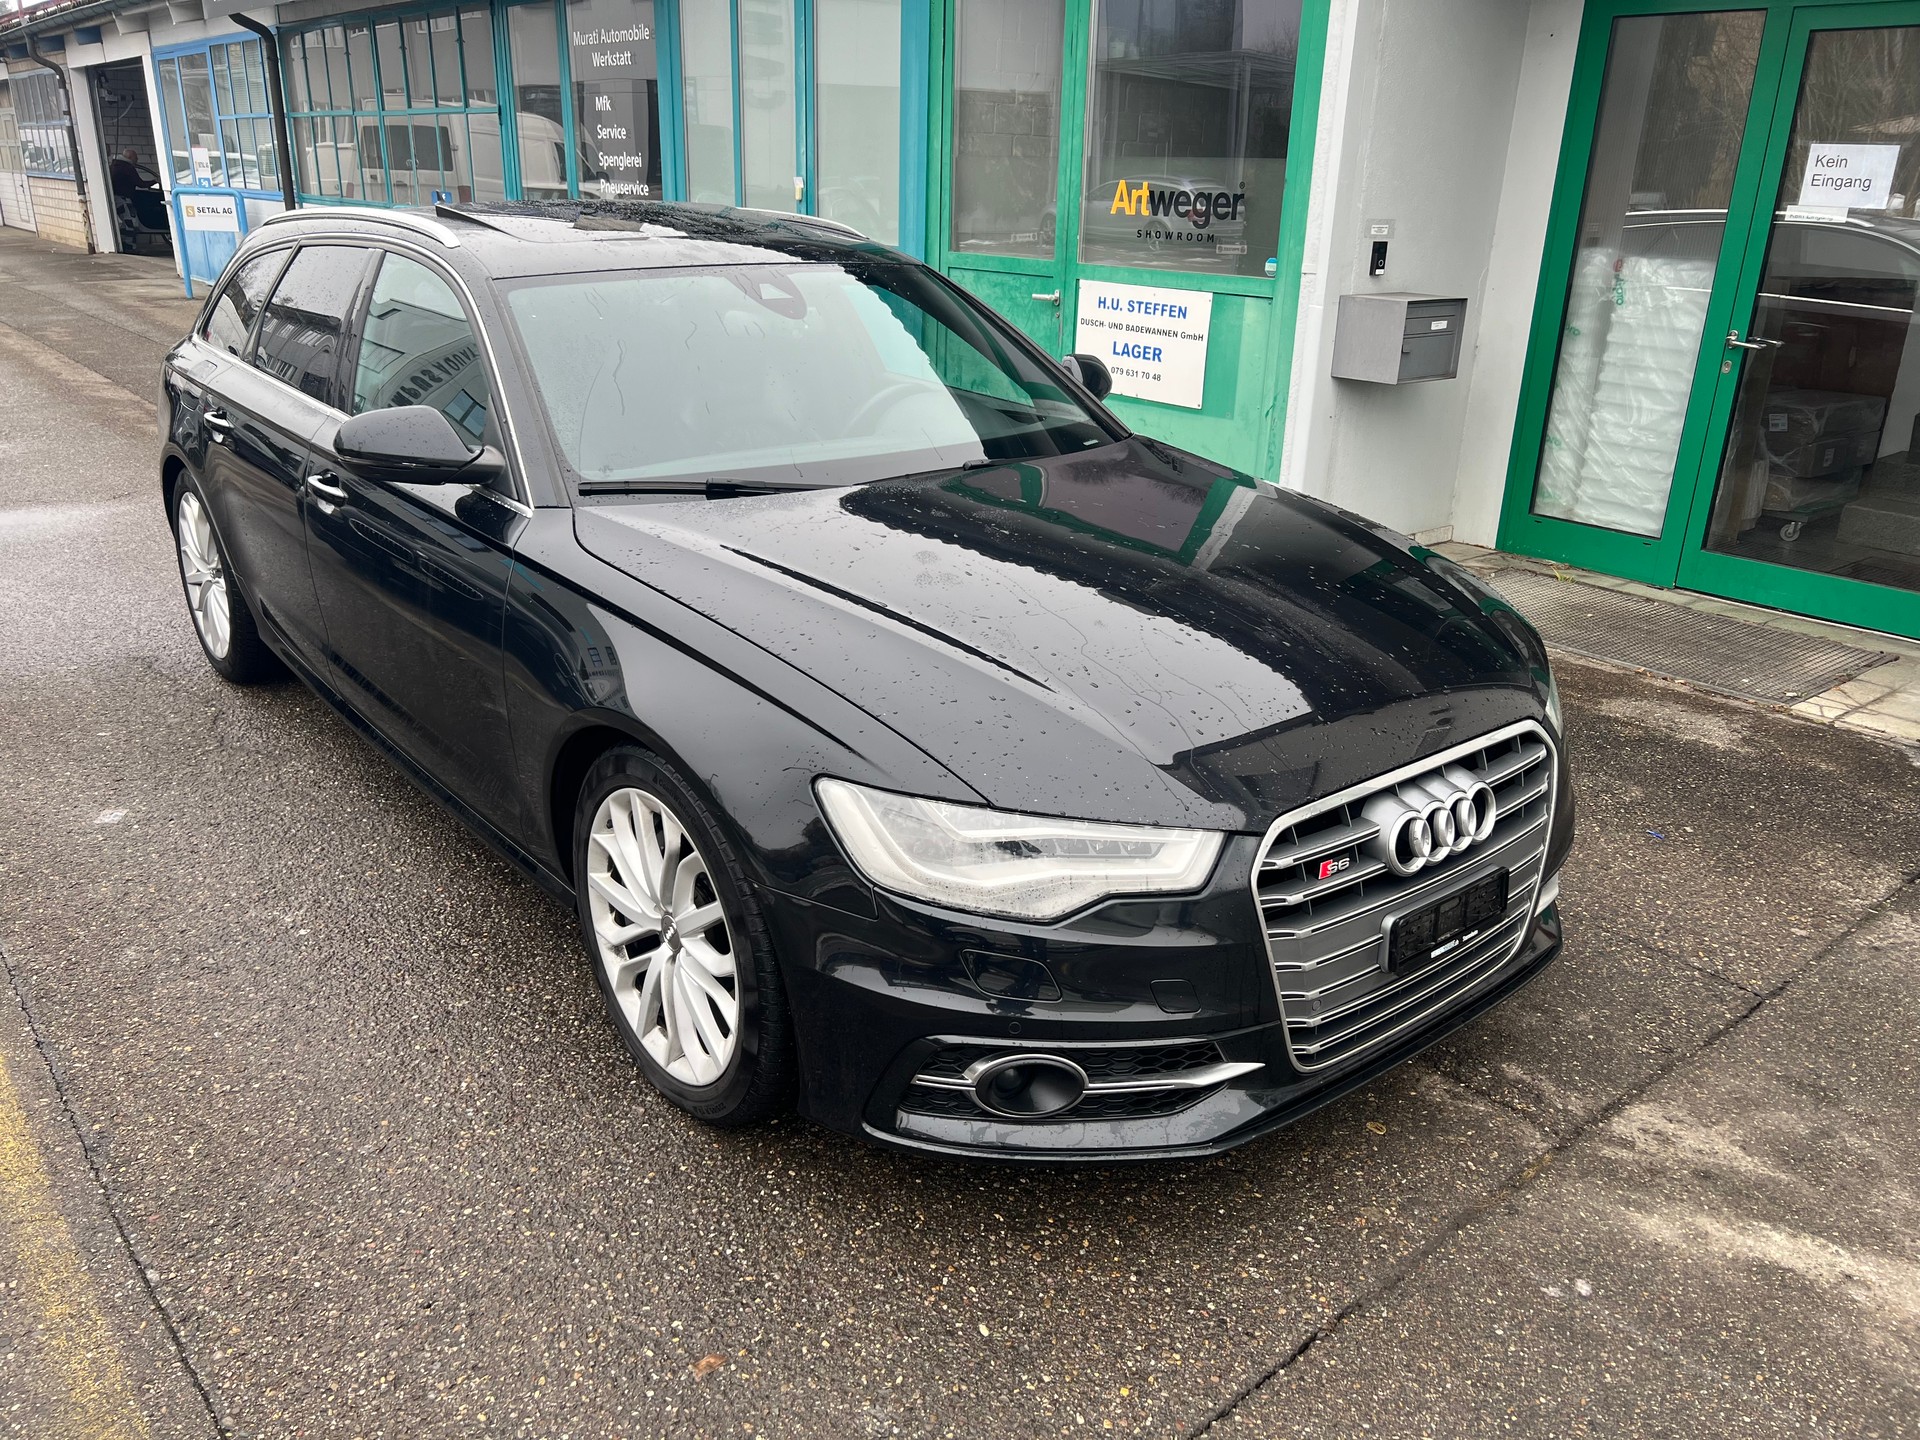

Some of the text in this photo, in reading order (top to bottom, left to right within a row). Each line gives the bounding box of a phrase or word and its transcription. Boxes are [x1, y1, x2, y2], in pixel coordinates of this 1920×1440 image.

[573, 24, 650, 46] Murati Automobile
[592, 50, 632, 67] Werkstatt
[595, 95, 611, 111] Mfk
[597, 124, 627, 139] Service
[598, 152, 642, 171] Spenglerei
[1815, 154, 1848, 168] Kein
[600, 178, 649, 196] Pneuservice
[1811, 173, 1872, 192] Eingang
[196, 206, 220, 214] SETAL
[222, 207, 233, 215] AG
[1136, 229, 1215, 243] SHOWROOM
[1098, 296, 1188, 319] H.U. STEFFEN
[1080, 318, 1204, 342] DUSCH- UND BADEWANNEN GmbH
[1112, 340, 1162, 362] LAGER
[1110, 366, 1162, 382] 079 631 70 48
[1326, 857, 1350, 876] S6
